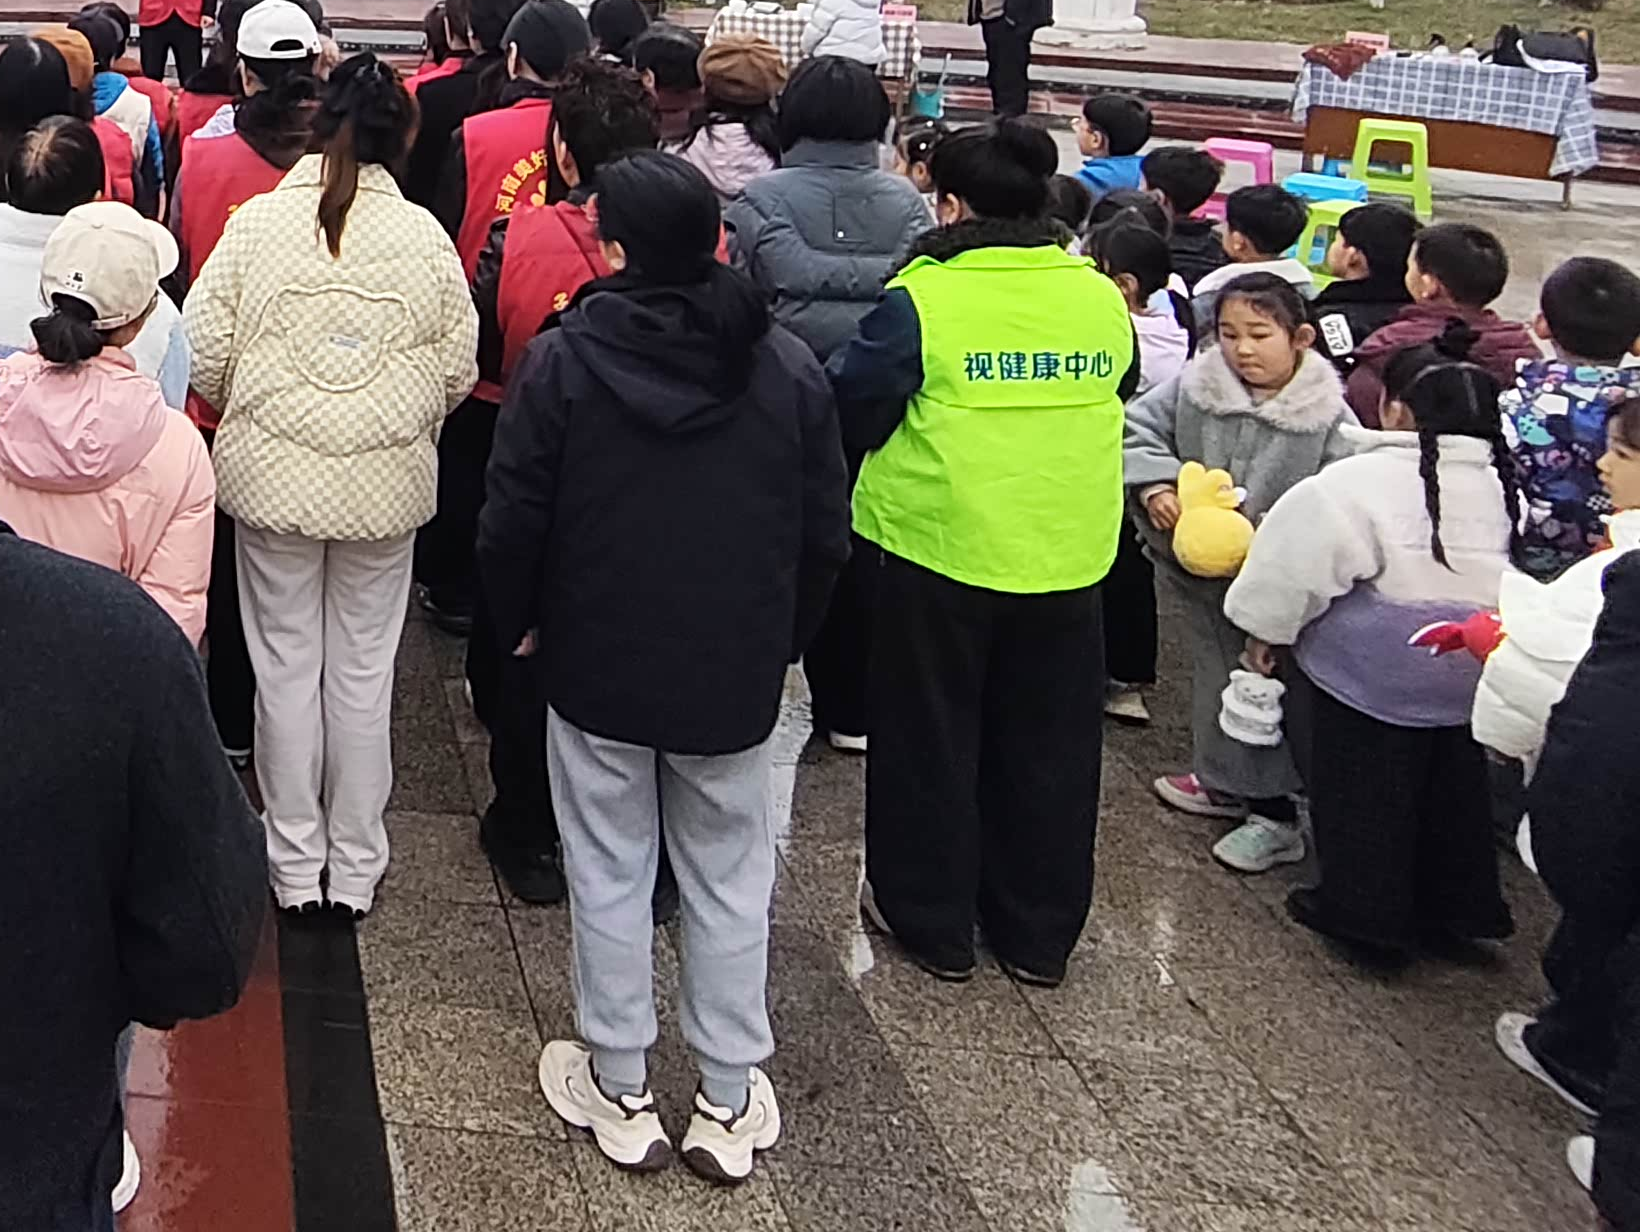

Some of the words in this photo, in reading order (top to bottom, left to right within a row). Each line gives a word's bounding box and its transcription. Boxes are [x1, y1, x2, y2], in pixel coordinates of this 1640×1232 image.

[963, 349, 1113, 381] 视健康中心
